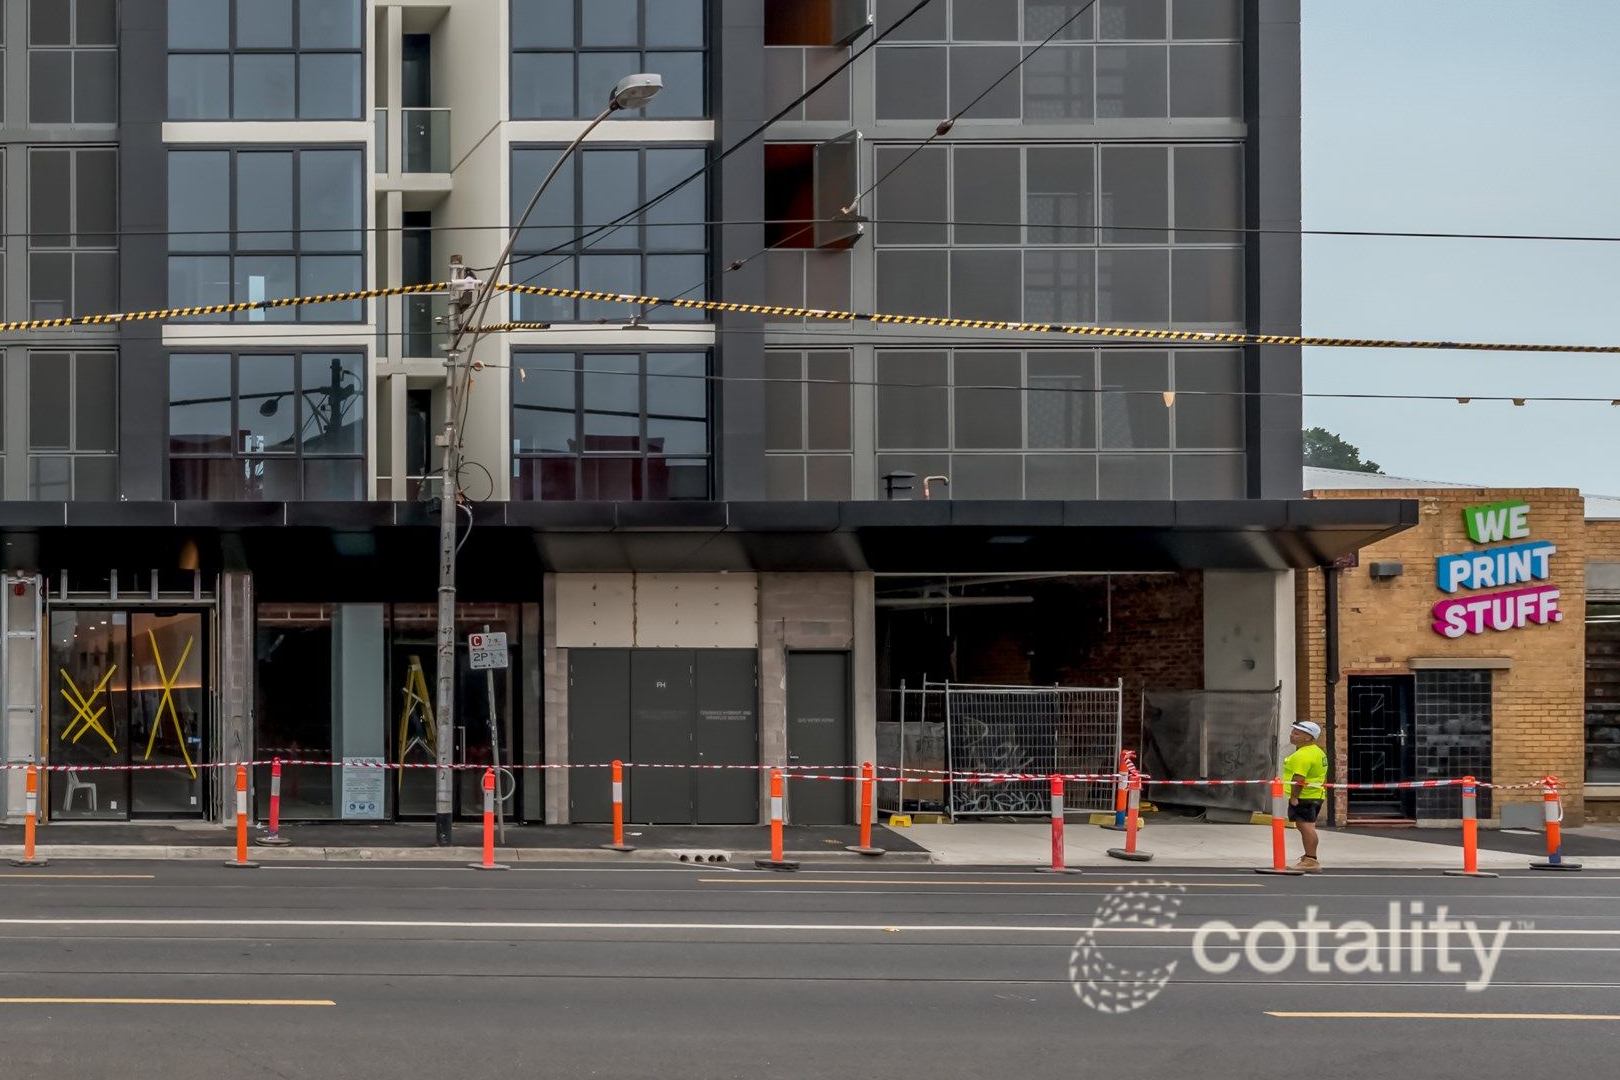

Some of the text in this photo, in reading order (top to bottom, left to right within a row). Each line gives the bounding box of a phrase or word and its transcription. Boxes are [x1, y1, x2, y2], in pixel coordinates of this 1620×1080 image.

[1475, 505, 1530, 543] WE
[1449, 546, 1556, 593] PRINT
[1444, 590, 1562, 638] STUFF.
[473, 652, 488, 662] 2P
